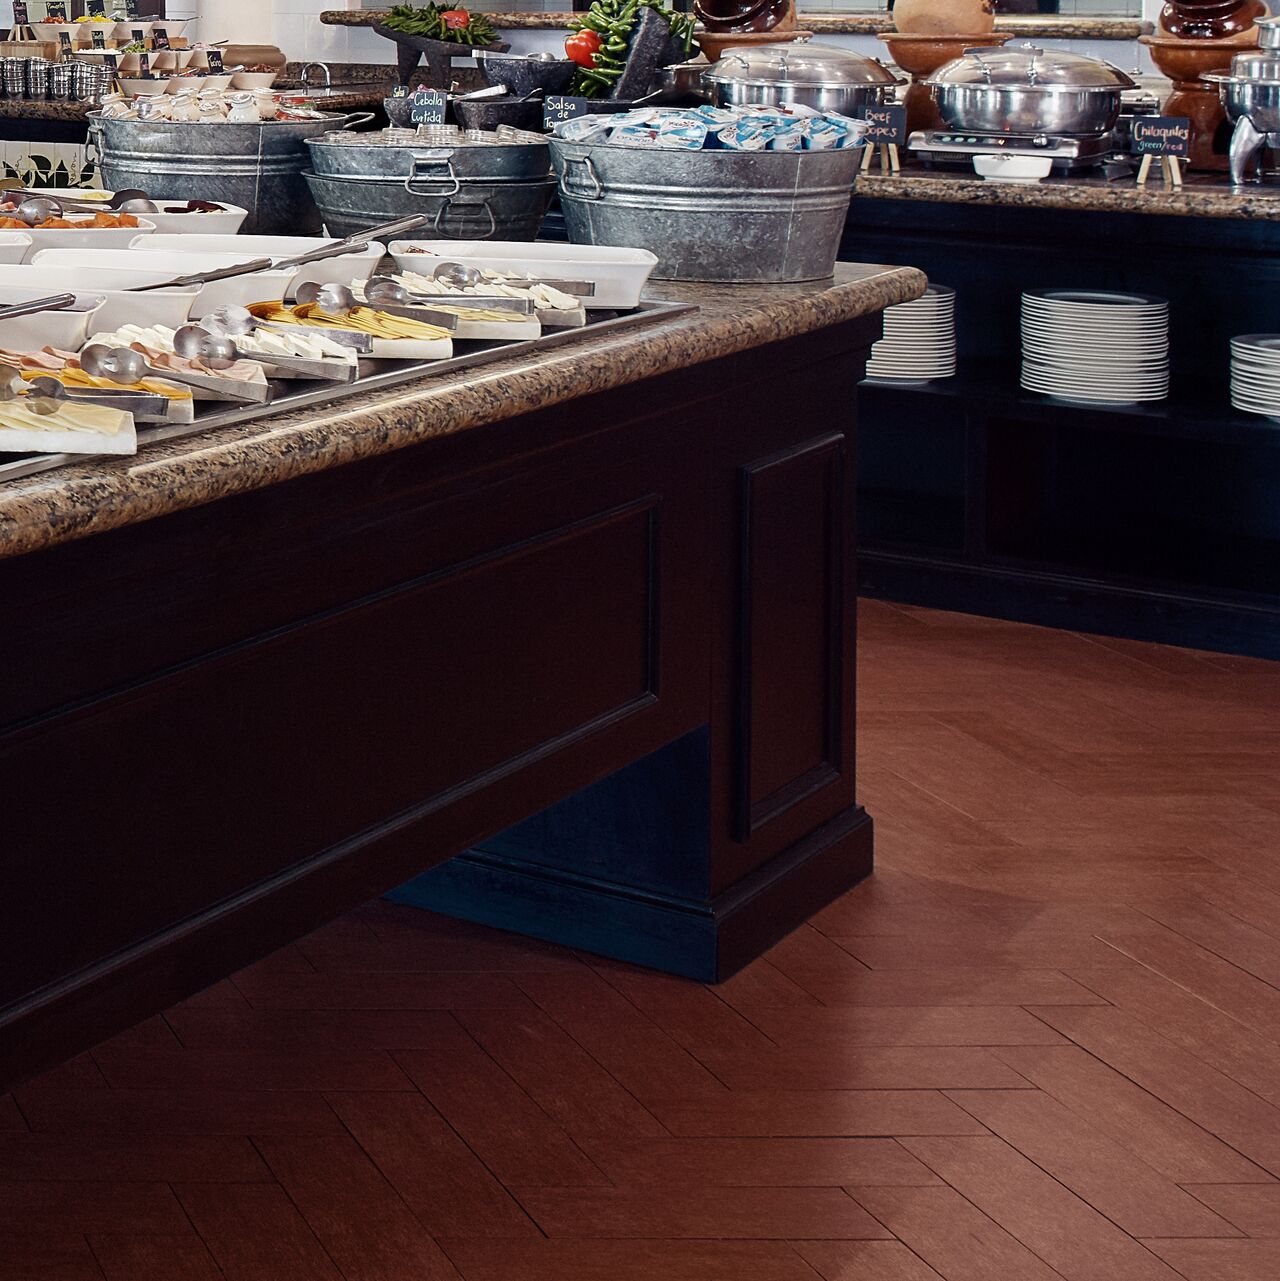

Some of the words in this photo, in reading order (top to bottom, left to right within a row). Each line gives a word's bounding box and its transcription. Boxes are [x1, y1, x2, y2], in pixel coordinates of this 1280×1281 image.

[414, 92, 443, 106] Cebolla
[547, 97, 576, 110] Salsa
[411, 110, 442, 123] Curtida
[557, 110, 569, 119] de
[865, 109, 891, 122] Beef
[1134, 121, 1189, 142] Chilaquiles
